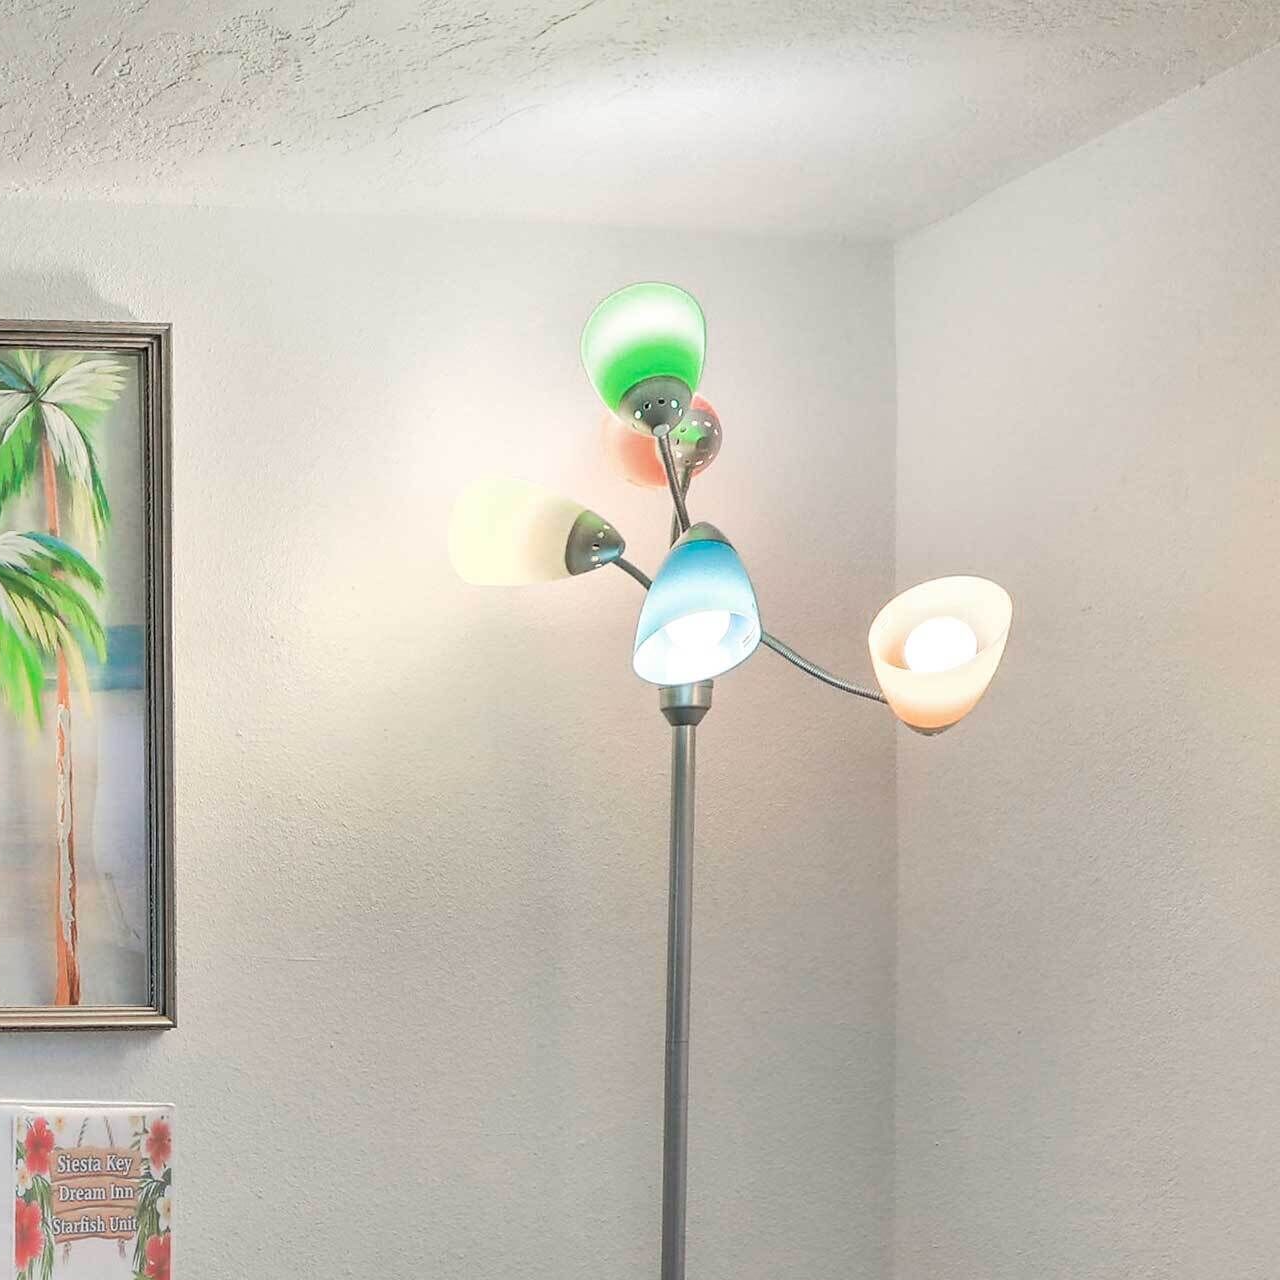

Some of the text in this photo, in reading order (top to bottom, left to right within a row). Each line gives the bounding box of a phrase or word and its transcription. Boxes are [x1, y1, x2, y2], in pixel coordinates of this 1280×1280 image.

[57, 1153, 133, 1175] Siesta Key
[58, 1184, 134, 1201] Dream Inn
[52, 1216, 138, 1235] Starfish Unit
